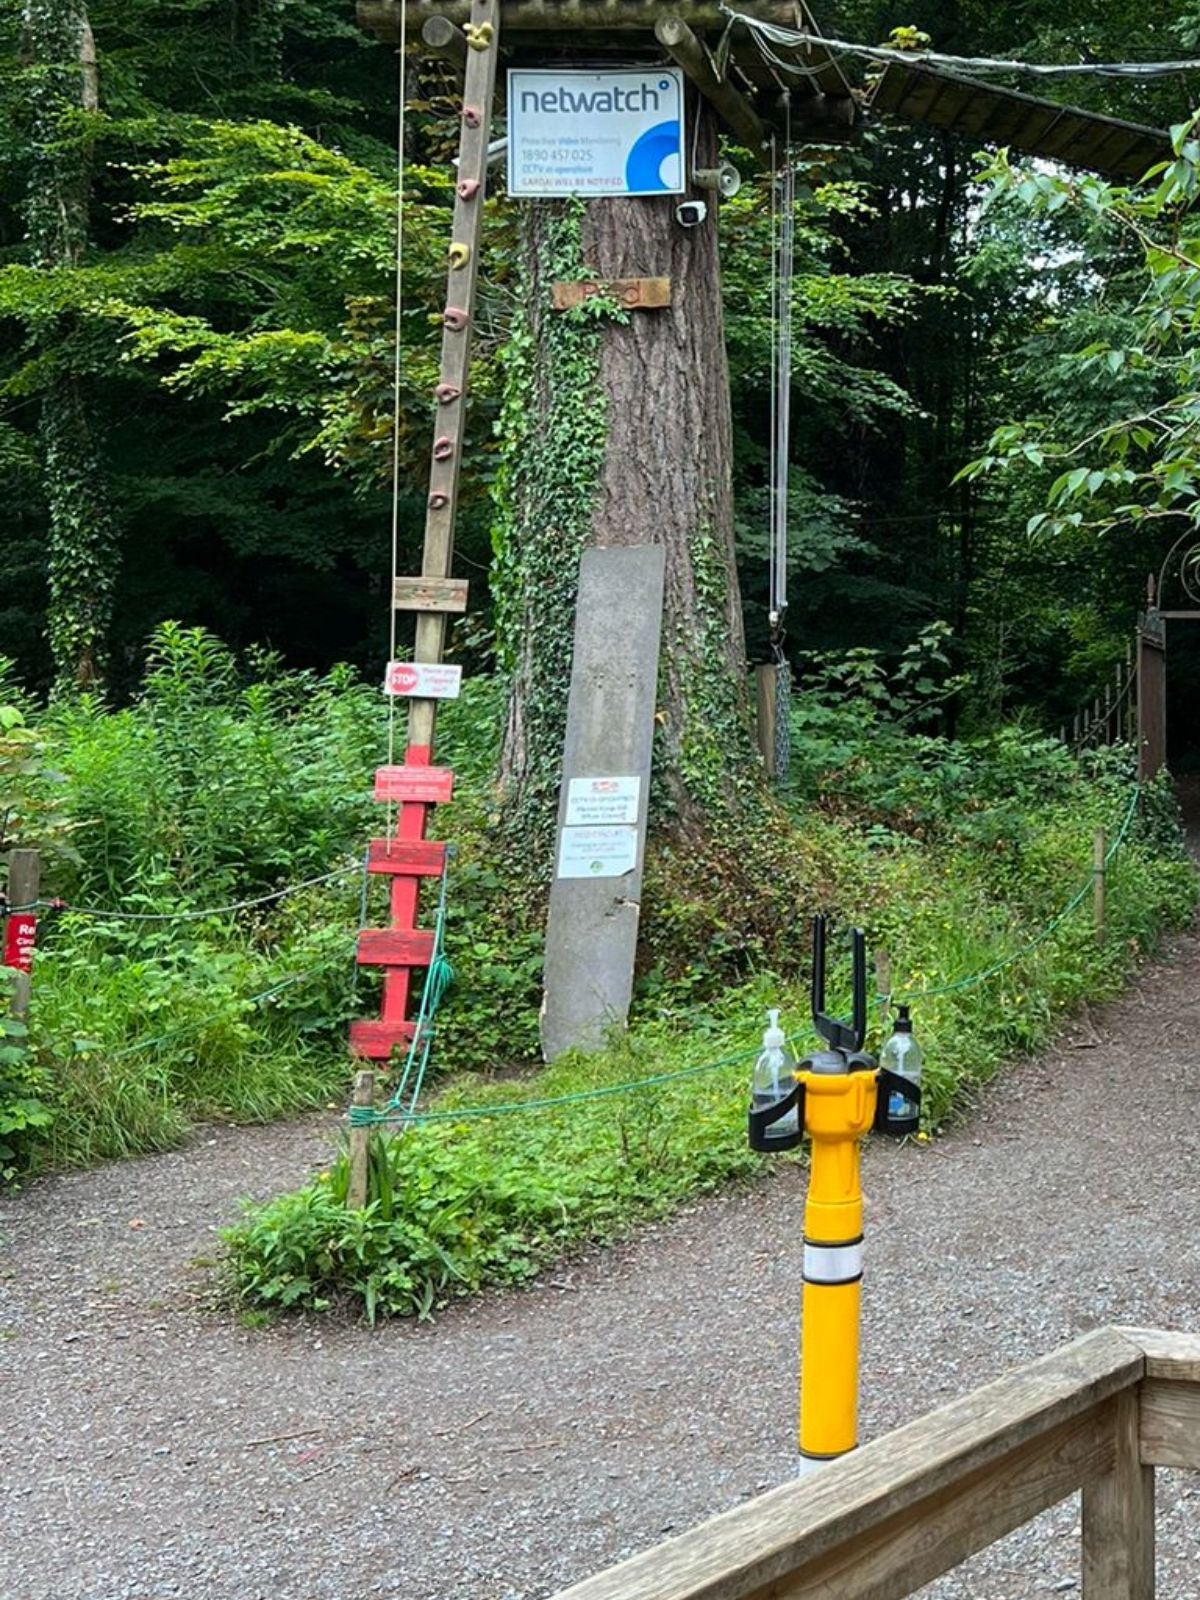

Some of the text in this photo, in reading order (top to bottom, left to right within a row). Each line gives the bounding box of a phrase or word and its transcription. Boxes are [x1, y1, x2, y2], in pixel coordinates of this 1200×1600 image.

[521, 82, 659, 113] netwatch
[522, 149, 593, 161] 1890 457 025
[522, 164, 543, 173] CCTV
[555, 178, 574, 186] WILL
[575, 178, 585, 186] BE
[587, 177, 623, 186] NOTIFIED
[391, 672, 417, 685] STOP
